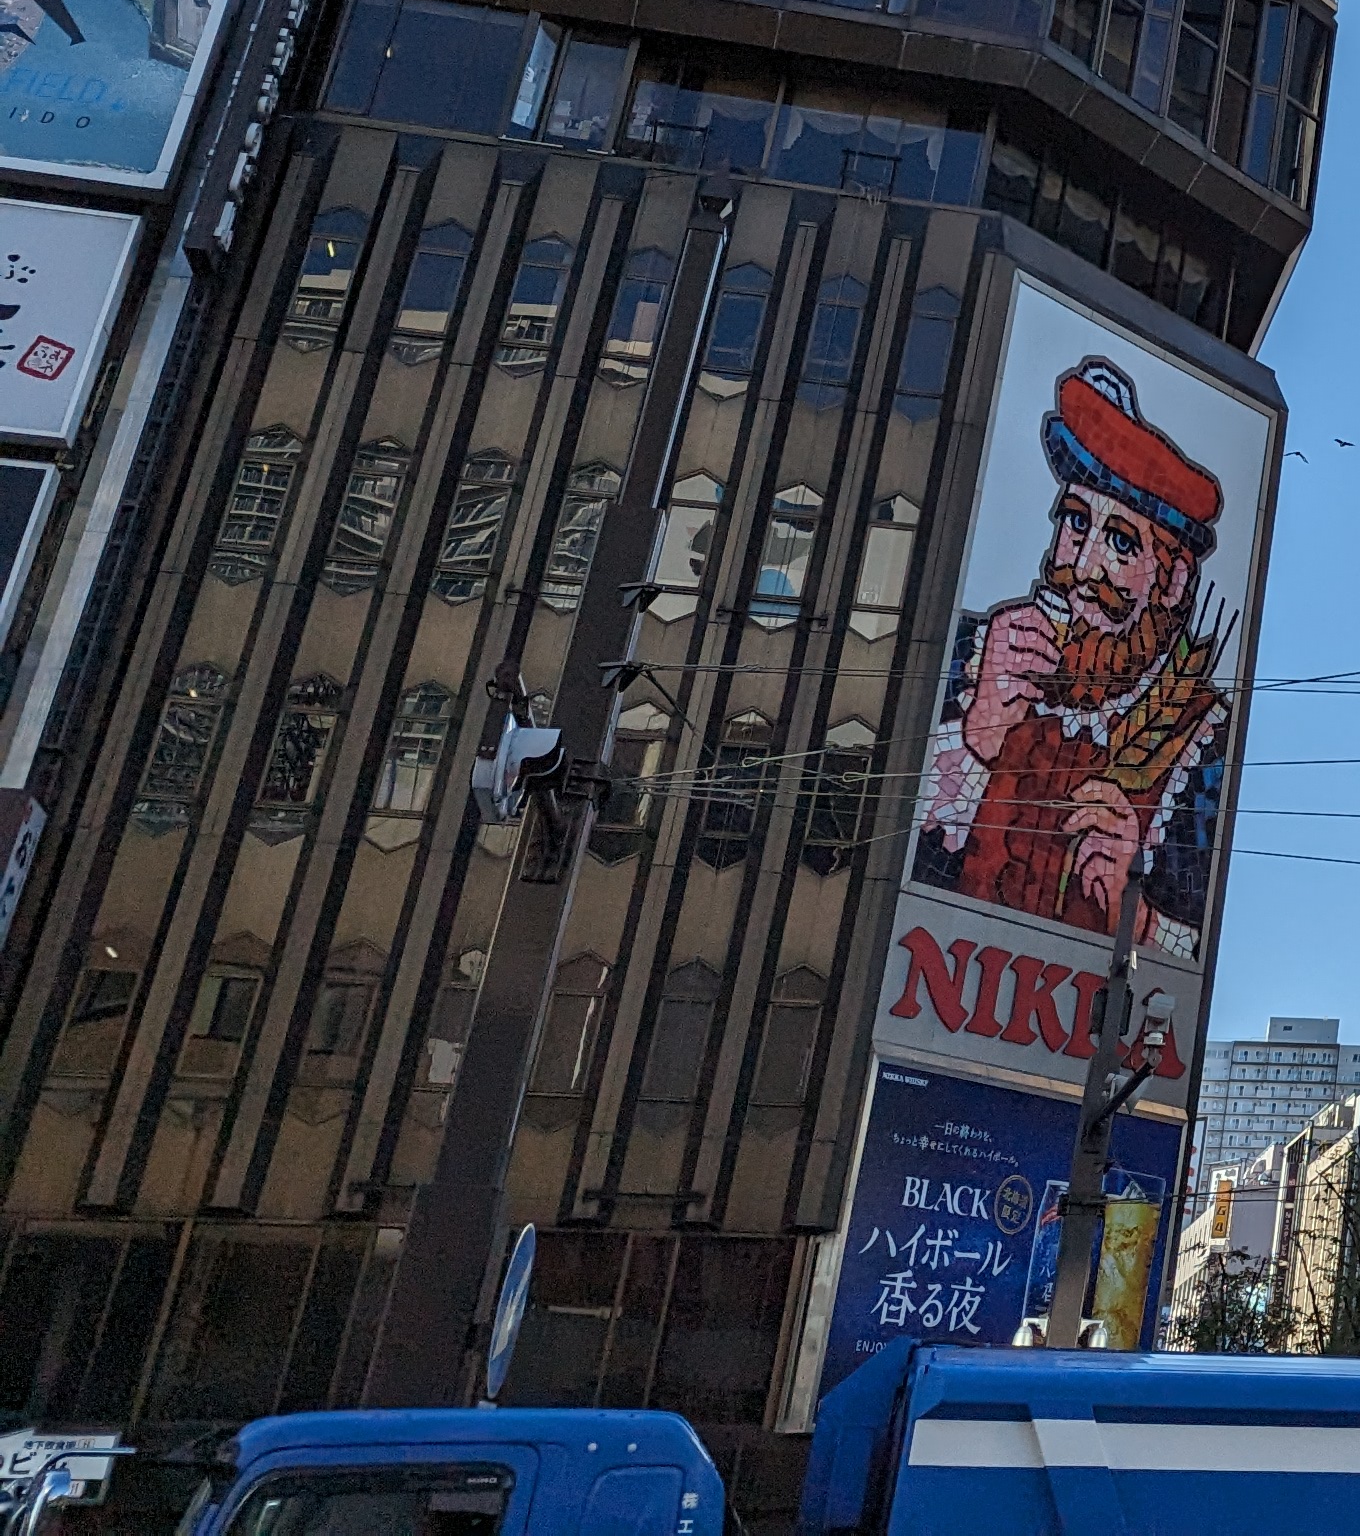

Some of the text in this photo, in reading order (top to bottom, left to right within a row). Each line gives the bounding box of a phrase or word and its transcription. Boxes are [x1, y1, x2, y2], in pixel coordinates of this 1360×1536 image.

[902, 1176, 991, 1220] BLACK
[858, 1223, 1013, 1277] ハイボール
[870, 1269, 986, 1335] 香る夜
